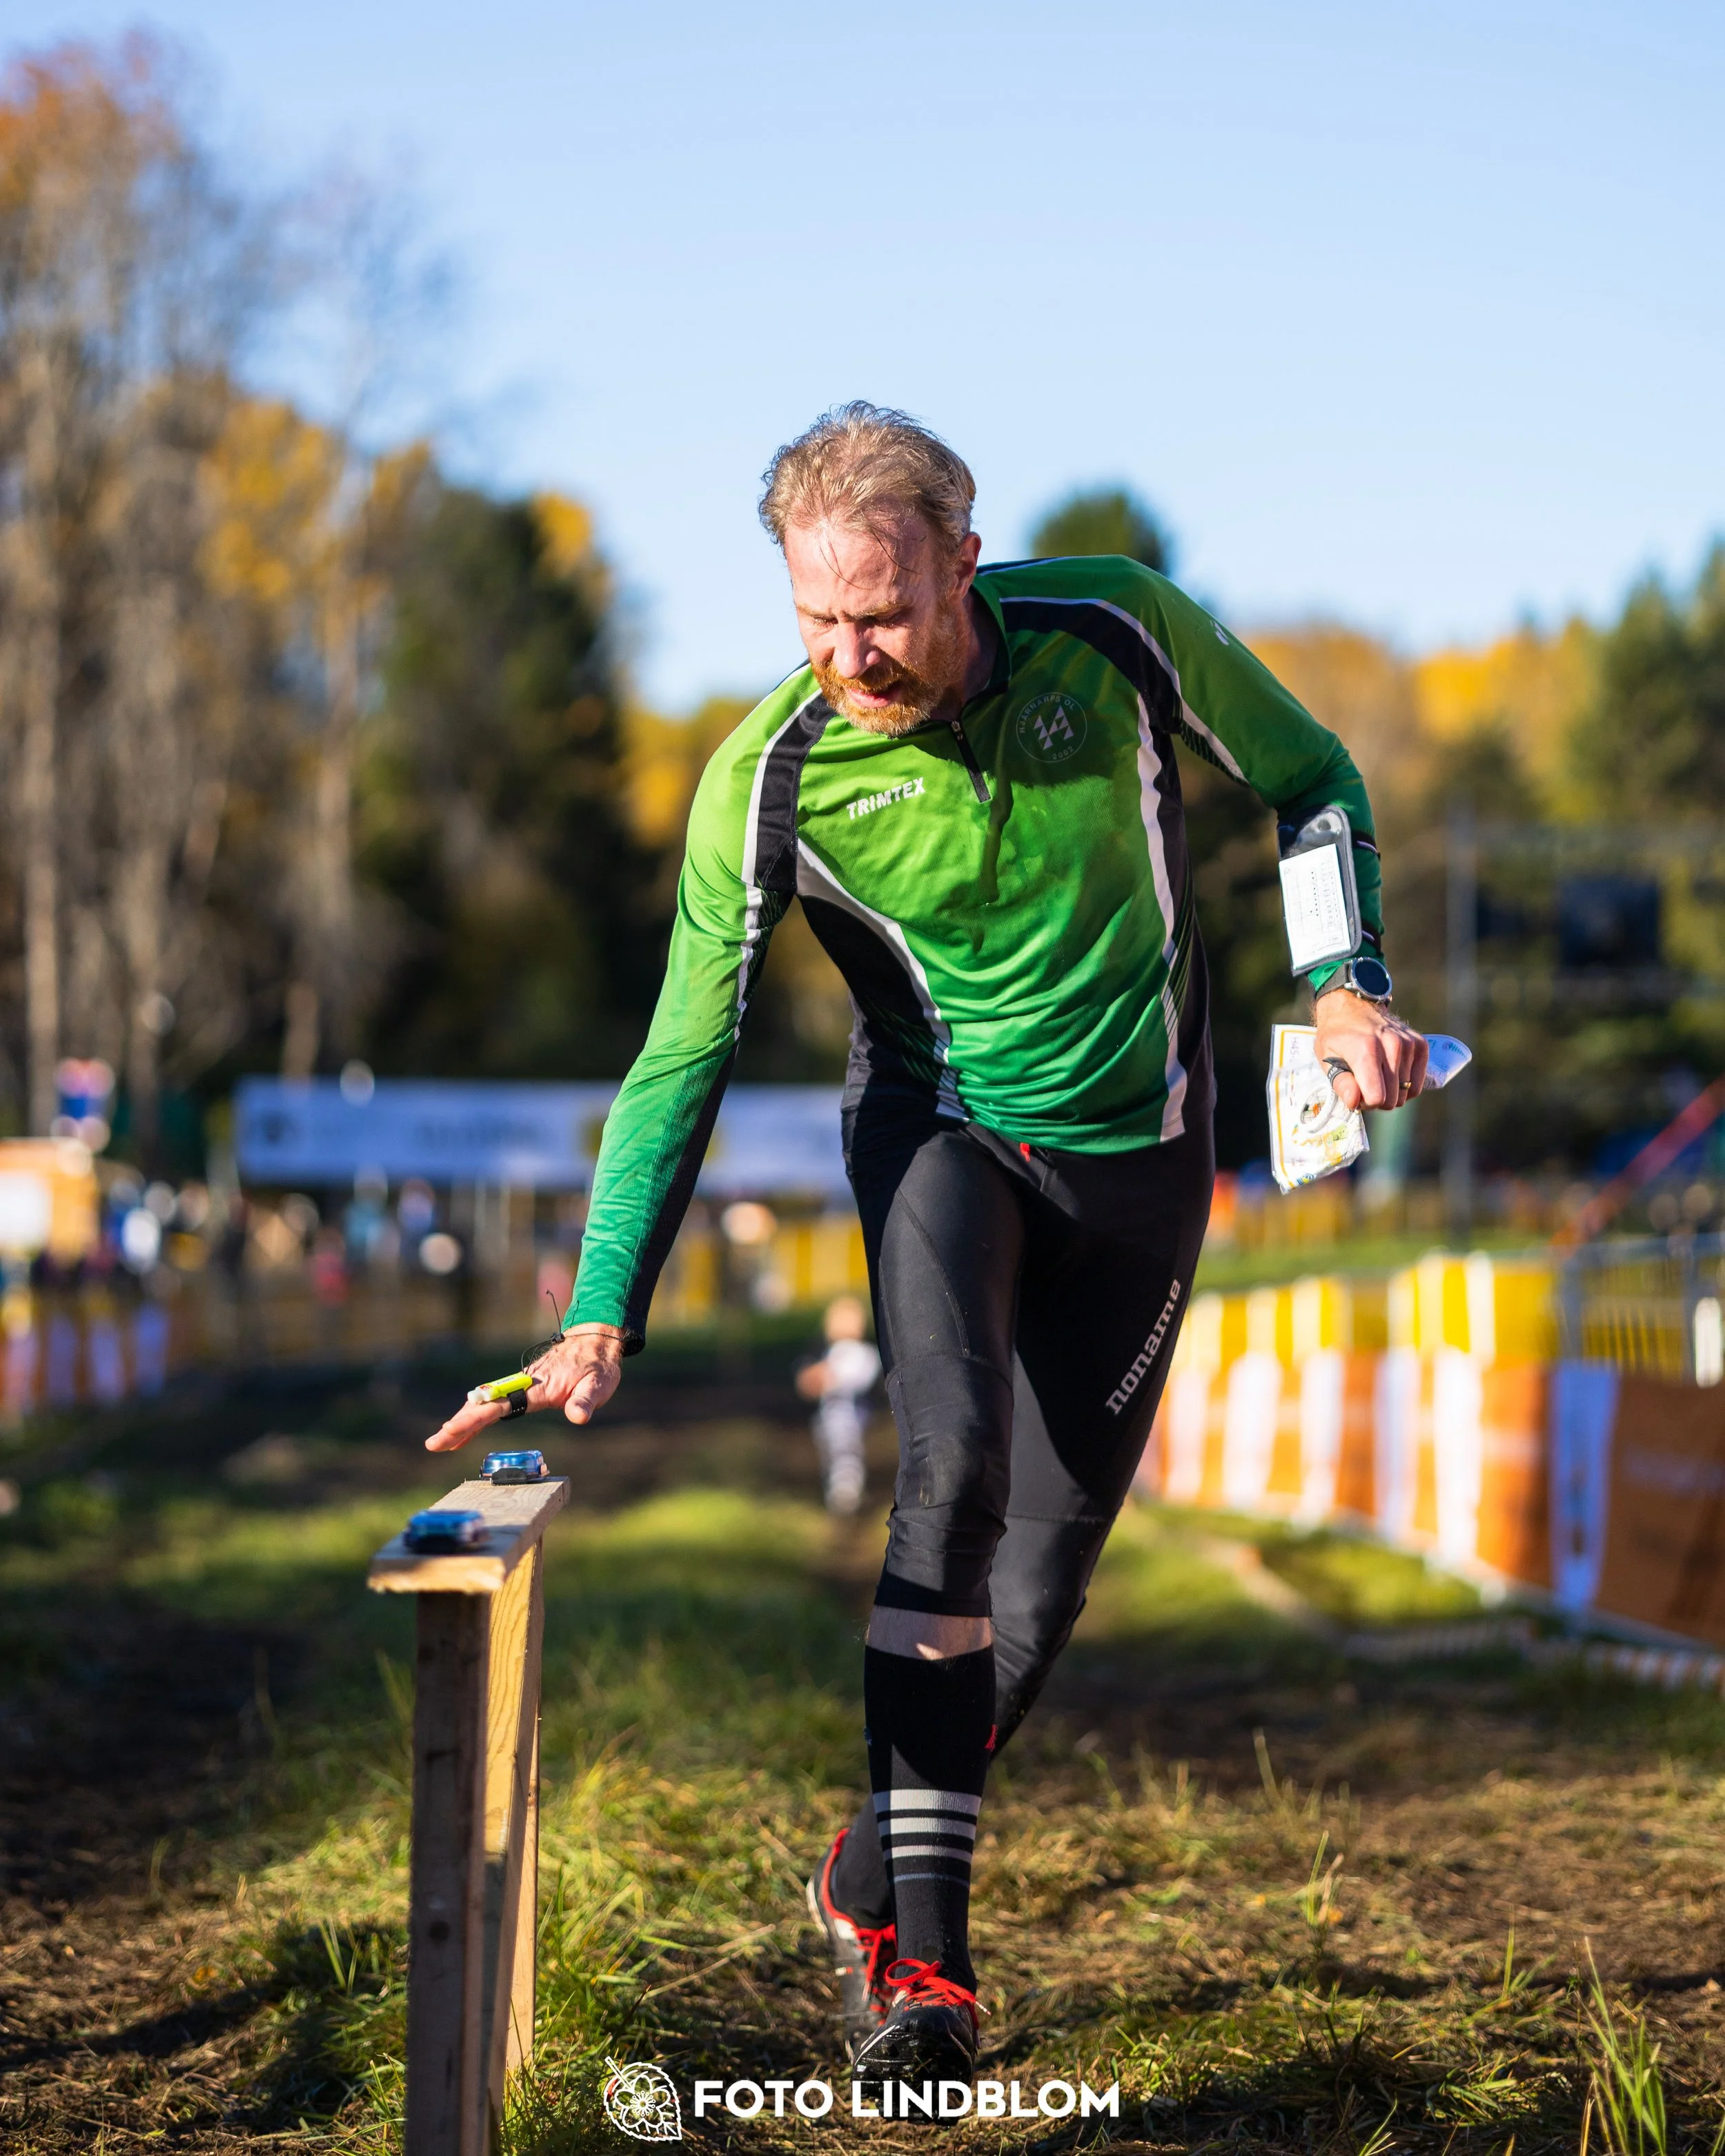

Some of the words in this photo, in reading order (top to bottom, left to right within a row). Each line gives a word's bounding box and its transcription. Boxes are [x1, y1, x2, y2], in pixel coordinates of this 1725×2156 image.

[1052, 746, 1074, 760] 2002
[846, 777, 925, 820] TRIMTEX
[1105, 1279, 1181, 1415] noname
